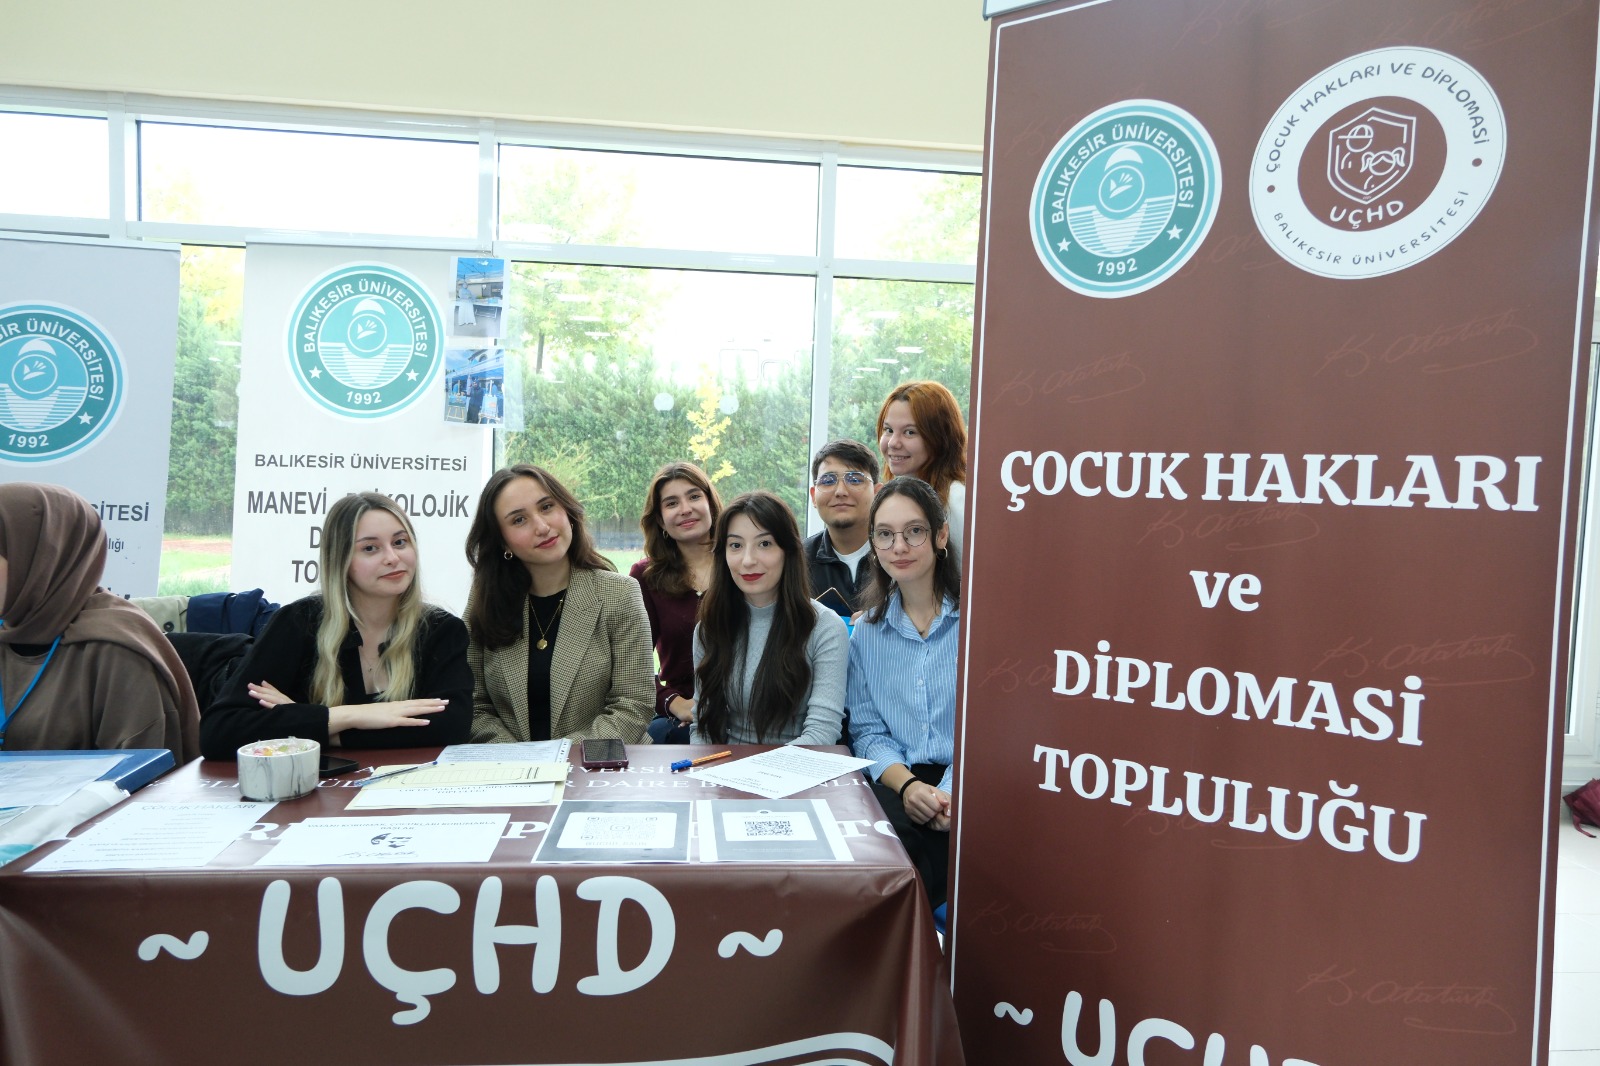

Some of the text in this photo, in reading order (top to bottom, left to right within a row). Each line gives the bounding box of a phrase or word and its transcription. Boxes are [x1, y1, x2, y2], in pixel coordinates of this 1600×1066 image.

[1265, 61, 1491, 174] ÇOCUK HAKLARI VE DİPLOMASİ
[1051, 121, 1195, 224] BALIKESİR ÜNİVERSİTESİ
[1272, 211, 1343, 265] BALIKESİR
[1351, 189, 1470, 266] ÜNİVERSİTESİ
[1329, 199, 1405, 230] UÇHD
[1096, 257, 1138, 276] 1992
[303, 278, 429, 358] BALIKESİR ÜNİVERSİTESİ
[26, 317, 105, 401] ÜNİVERSİTESİ
[346, 390, 383, 405] 1992
[8, 433, 50, 449] 1992
[254, 452, 468, 472] BALIKESİR ÜNİVERSİTESİ
[247, 486, 328, 515] MANEVİ
[1000, 450, 1543, 512] ÇOCUK HAKLARI
[1189, 569, 1263, 612] ve
[1051, 640, 1426, 747] DİPLOMASİ
[585, 778, 690, 788] DAİRE
[1032, 743, 1428, 864] TOPLULUĞU
[258, 875, 676, 1025] UÇHD
